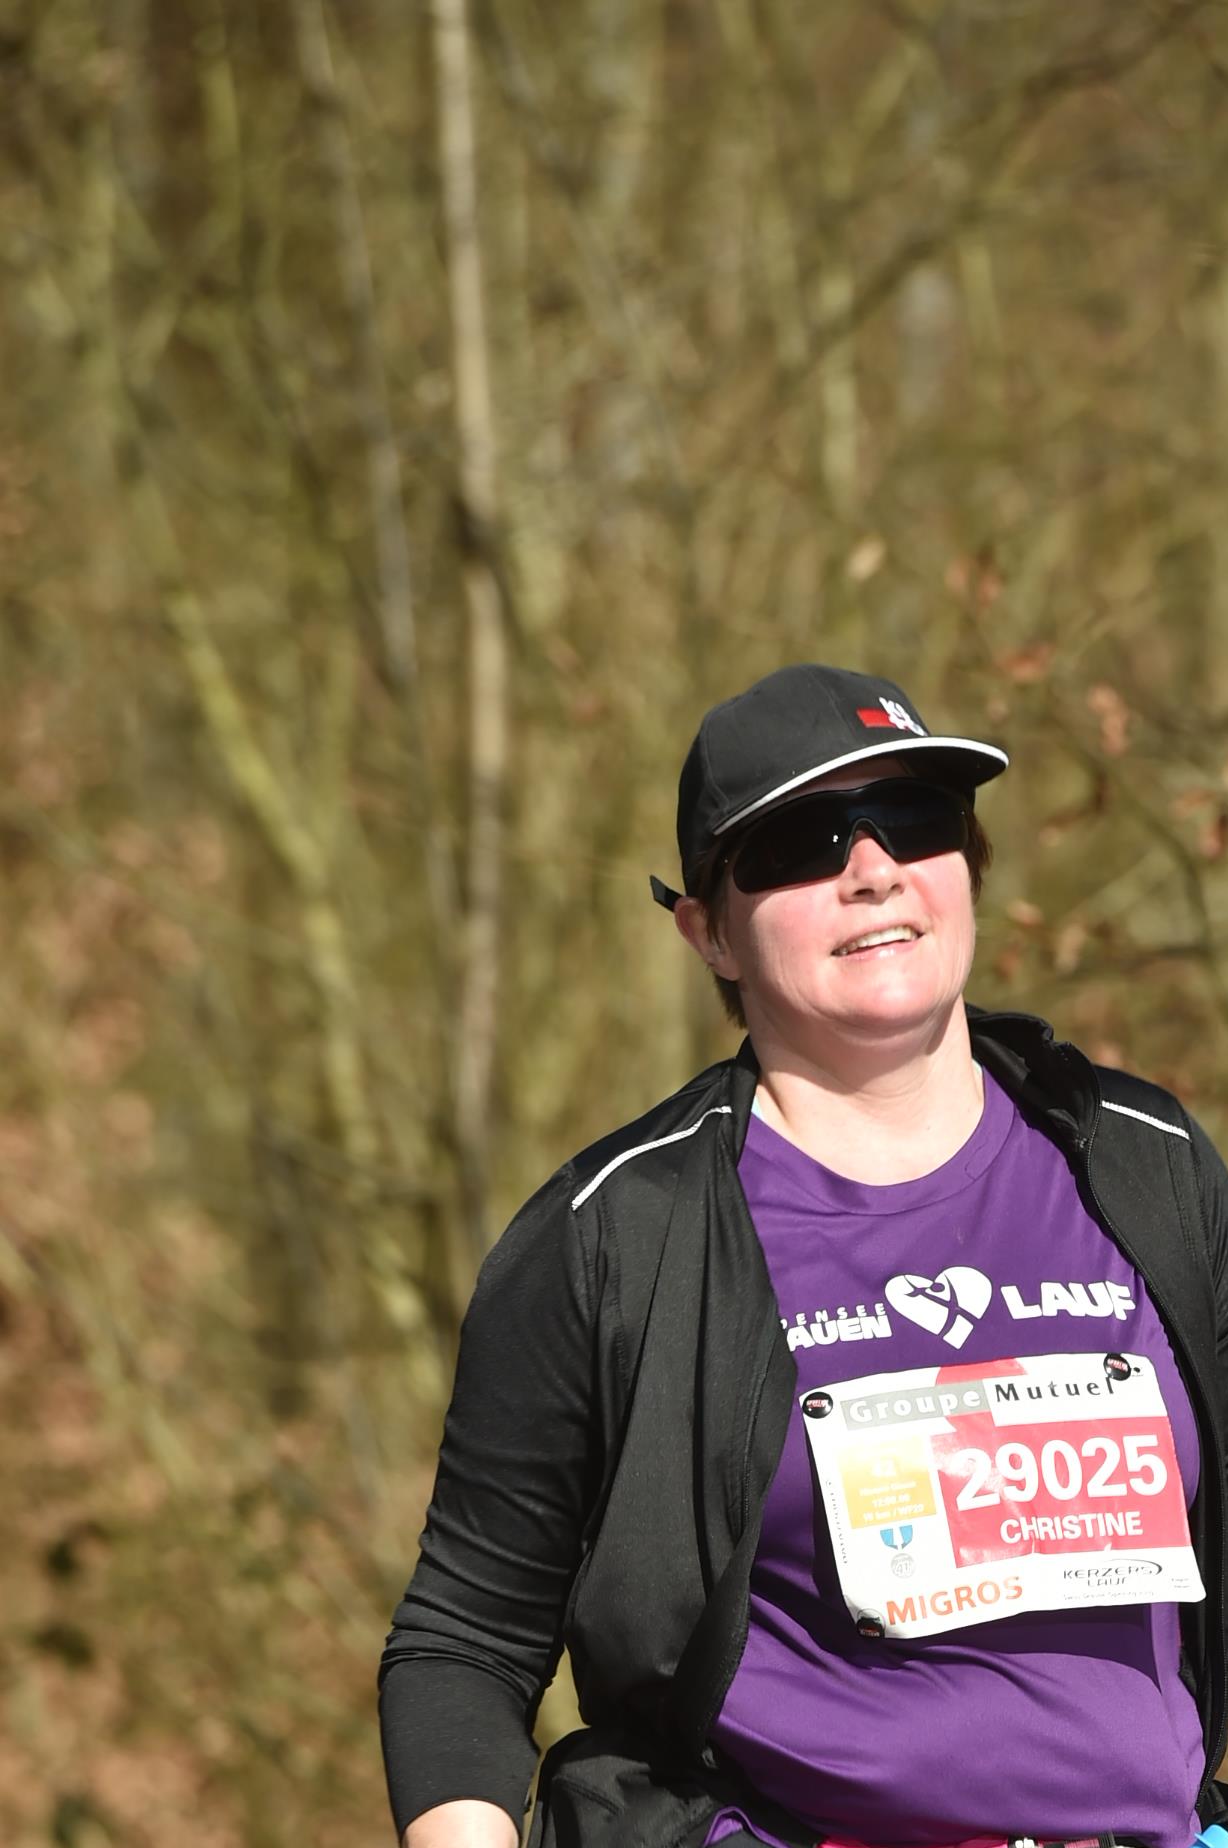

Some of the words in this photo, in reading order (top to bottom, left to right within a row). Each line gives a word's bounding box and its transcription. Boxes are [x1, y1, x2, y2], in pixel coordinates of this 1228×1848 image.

[1000, 1281, 1136, 1321] LAUF
[849, 1387, 981, 1423] Groupe
[994, 1375, 1115, 1403] Mutuel
[954, 1434, 1168, 1511] 29025
[999, 1511, 1144, 1544] CHRISTINE
[1063, 1565, 1153, 1580] KERZERS
[886, 1575, 1024, 1627] MIGROS
